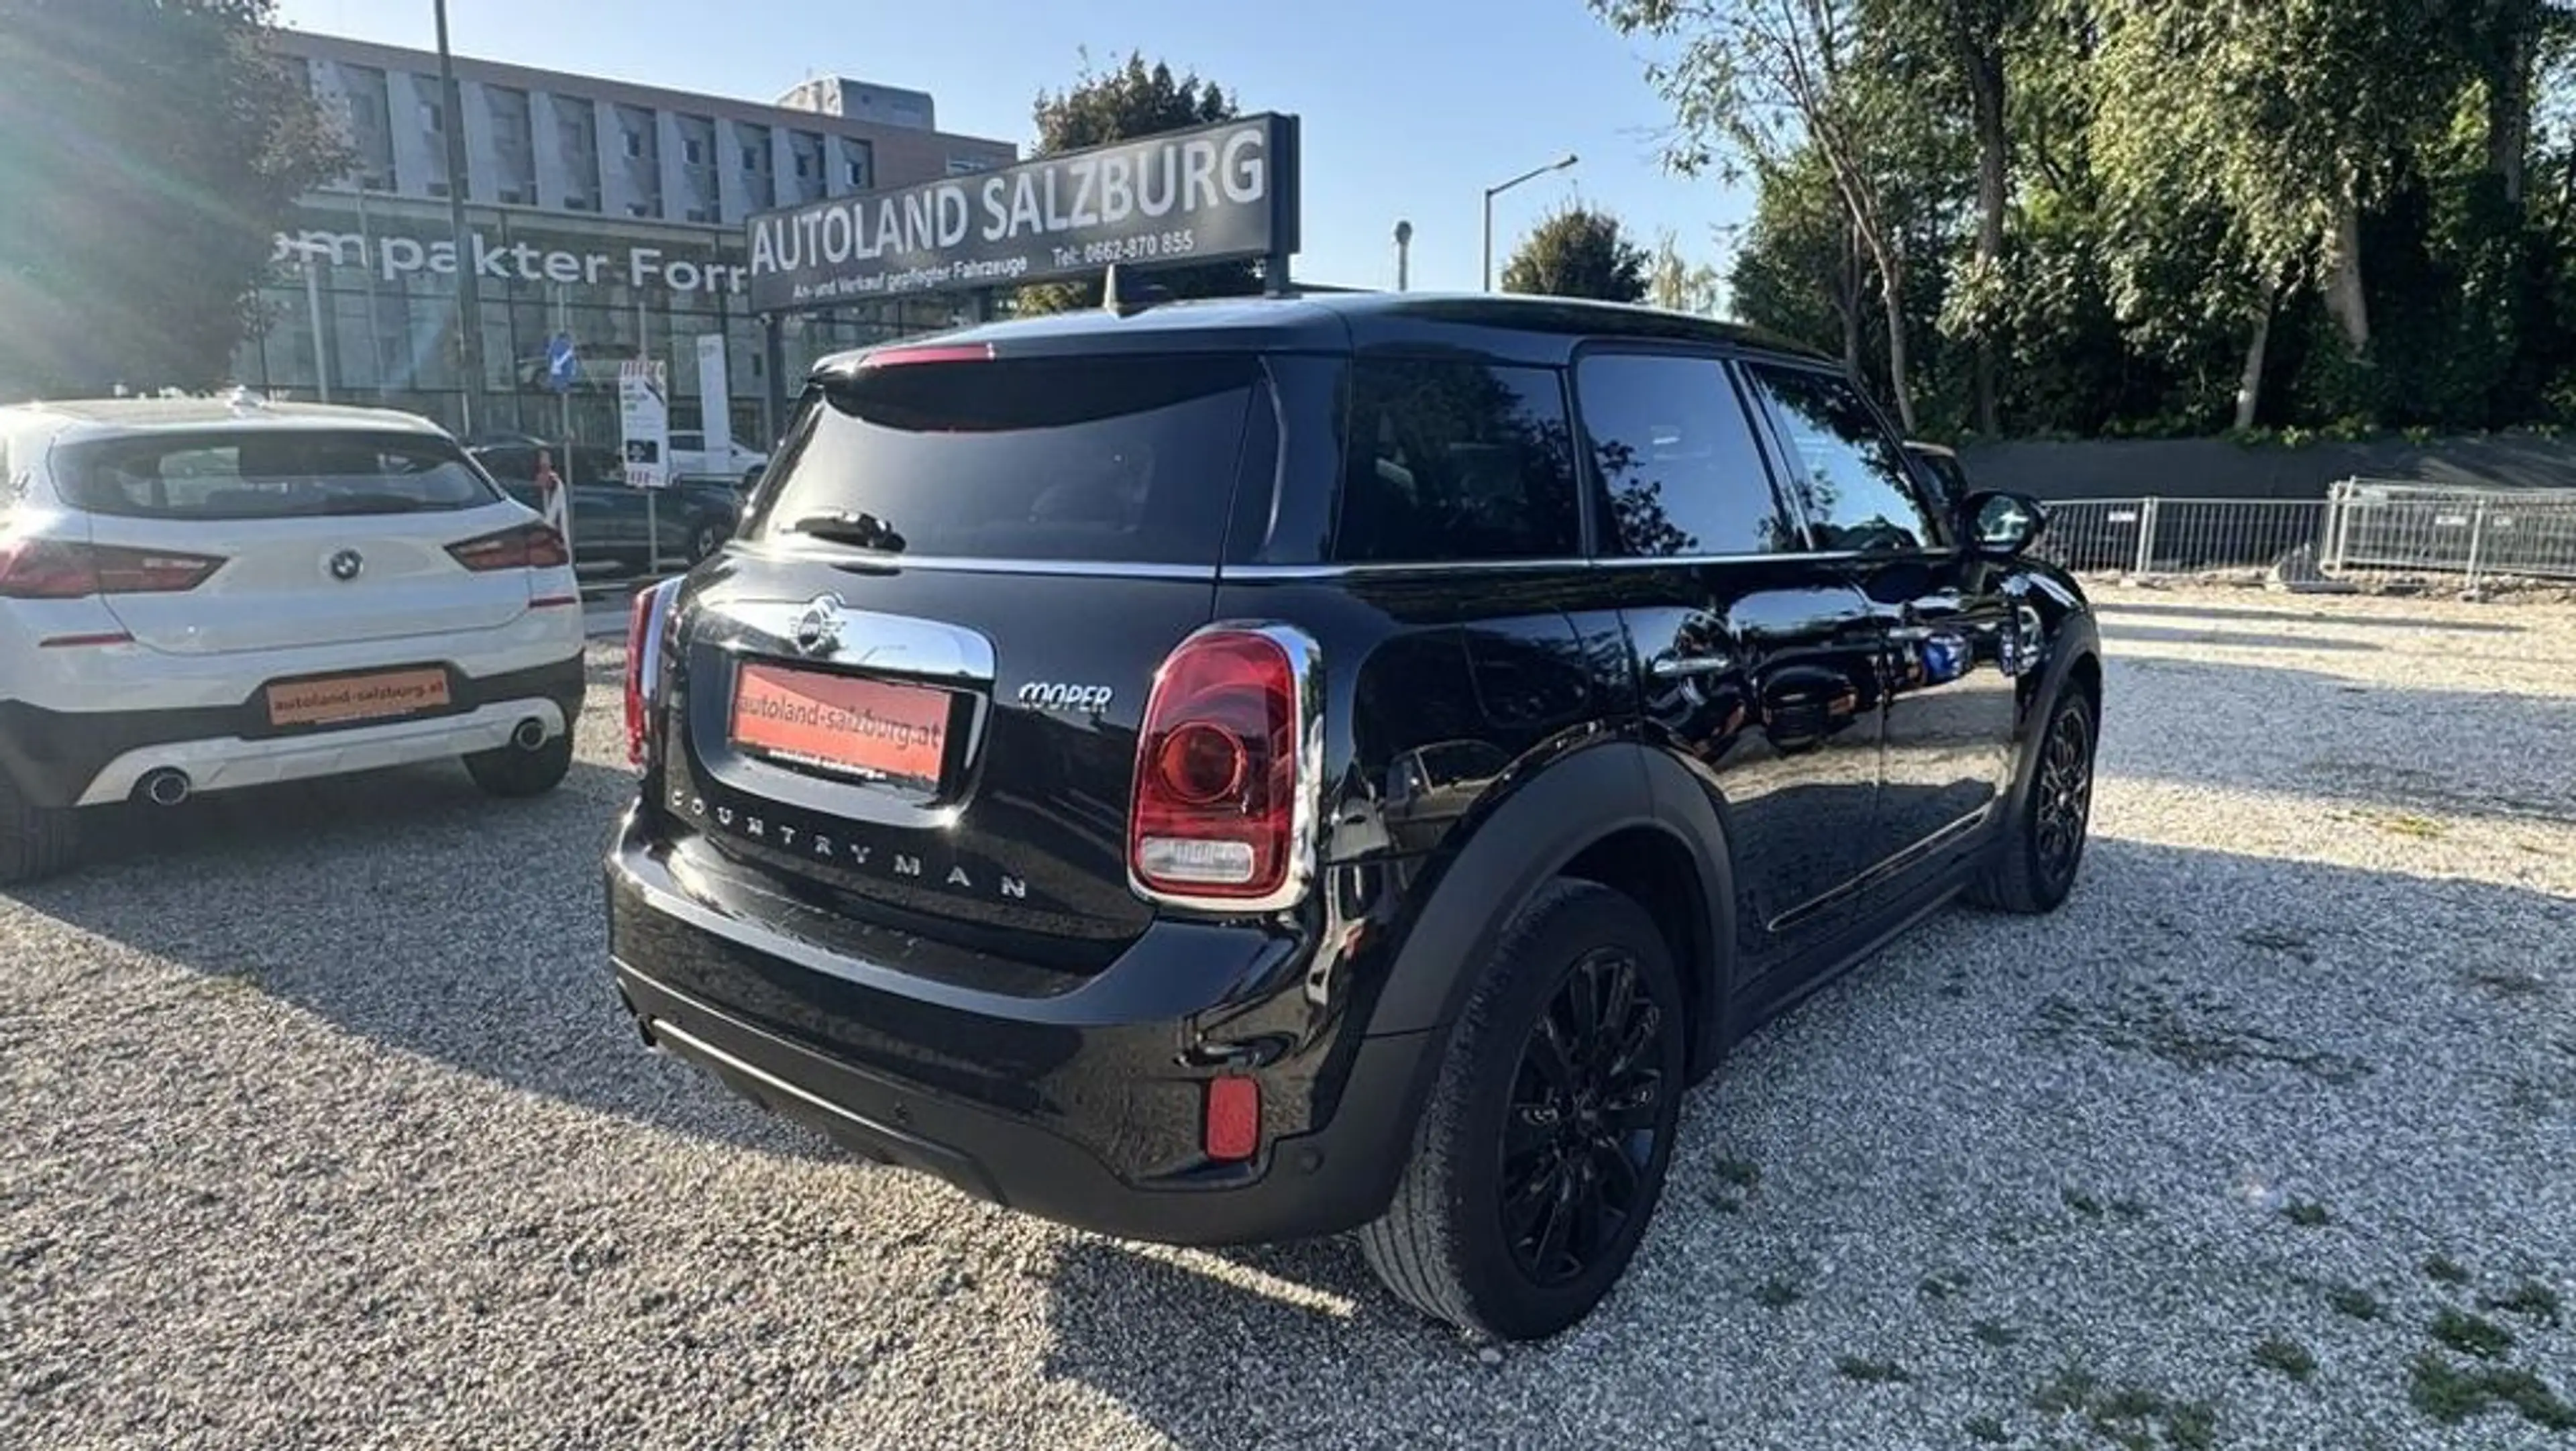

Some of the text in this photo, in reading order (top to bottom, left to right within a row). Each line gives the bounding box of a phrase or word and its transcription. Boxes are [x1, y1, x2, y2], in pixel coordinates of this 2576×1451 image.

[751, 128, 1263, 277] AUTOLAND SALZBURG
[269, 229, 608, 284] ompakter
[1084, 233, 1157, 264] 0662-870
[1161, 229, 1194, 254] 855
[839, 271, 885, 294] Verkauf
[953, 256, 1028, 279] Fahrzeuge
[738, 692, 941, 750] autoland-salzburg.at
[1018, 681, 1114, 714] COOPER
[672, 789, 1026, 899] COUNTRYMAN
